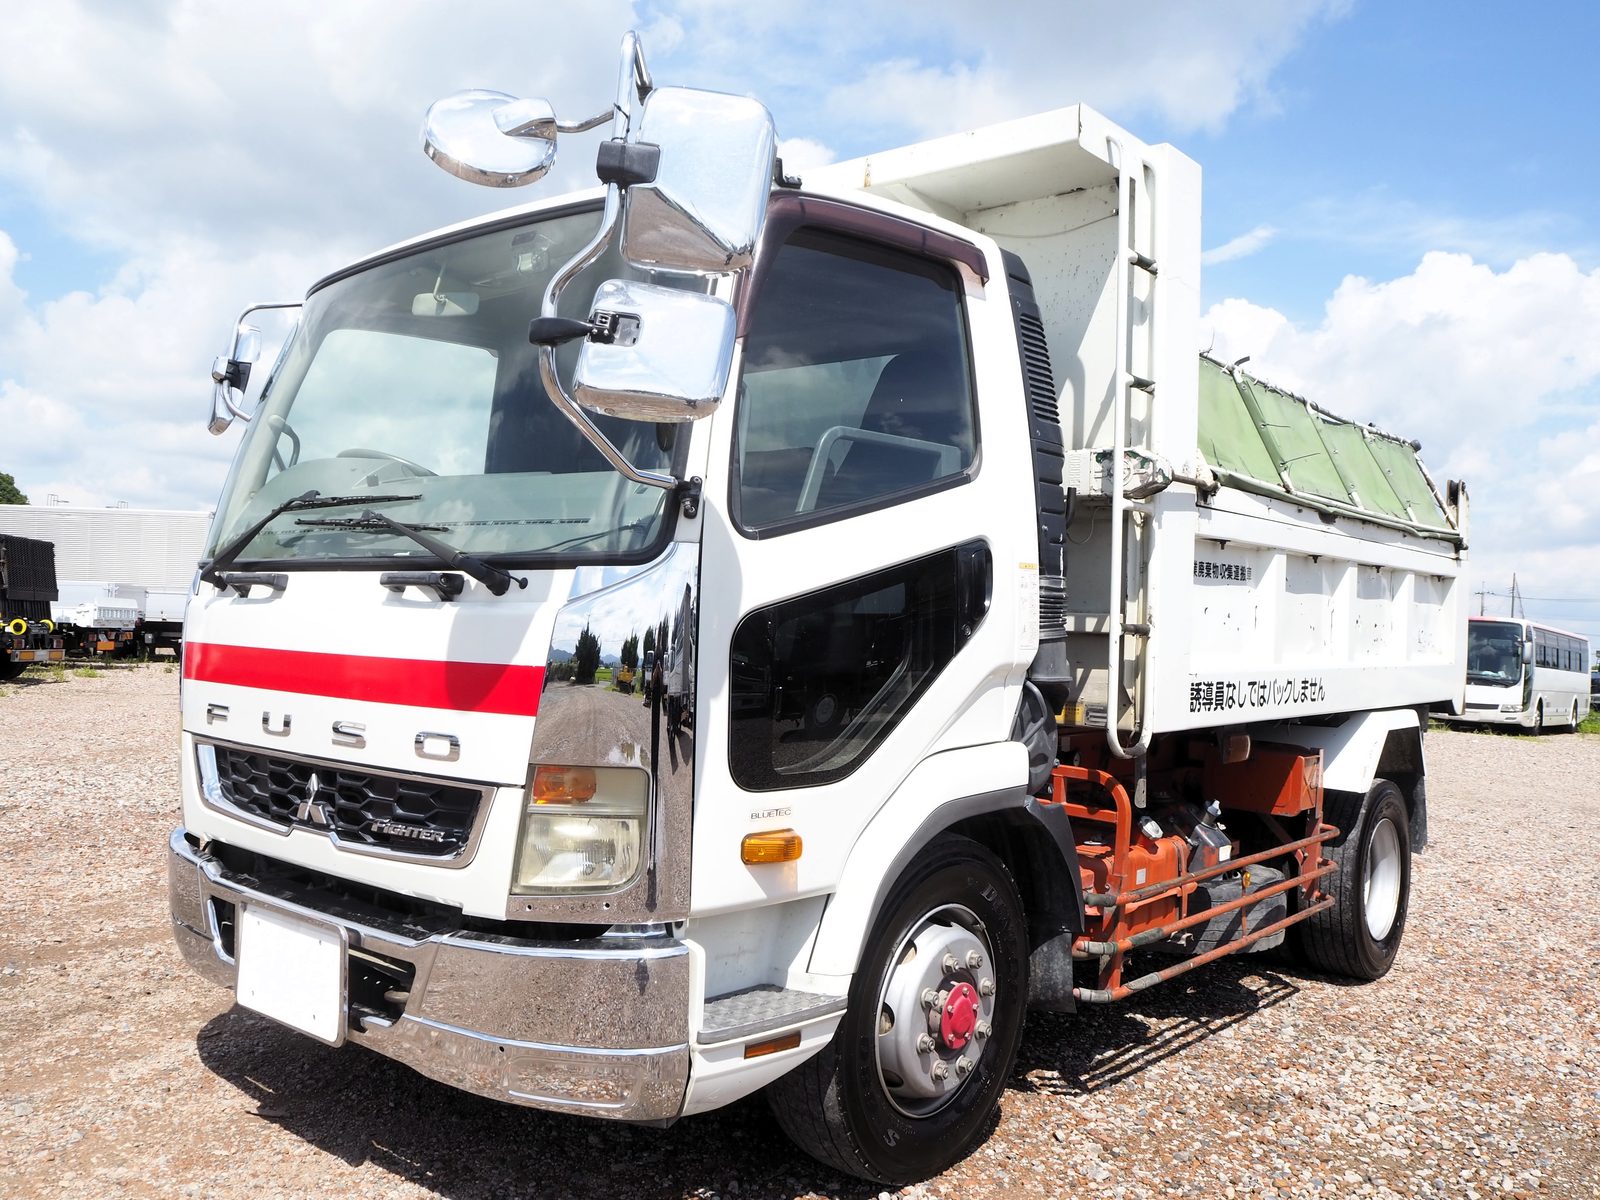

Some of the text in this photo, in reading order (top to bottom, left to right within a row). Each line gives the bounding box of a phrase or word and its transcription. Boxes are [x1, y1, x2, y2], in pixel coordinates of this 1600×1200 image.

[1189, 677, 1326, 713] 誘導員なしではバックしません
[206, 703, 460, 762] FUSO
